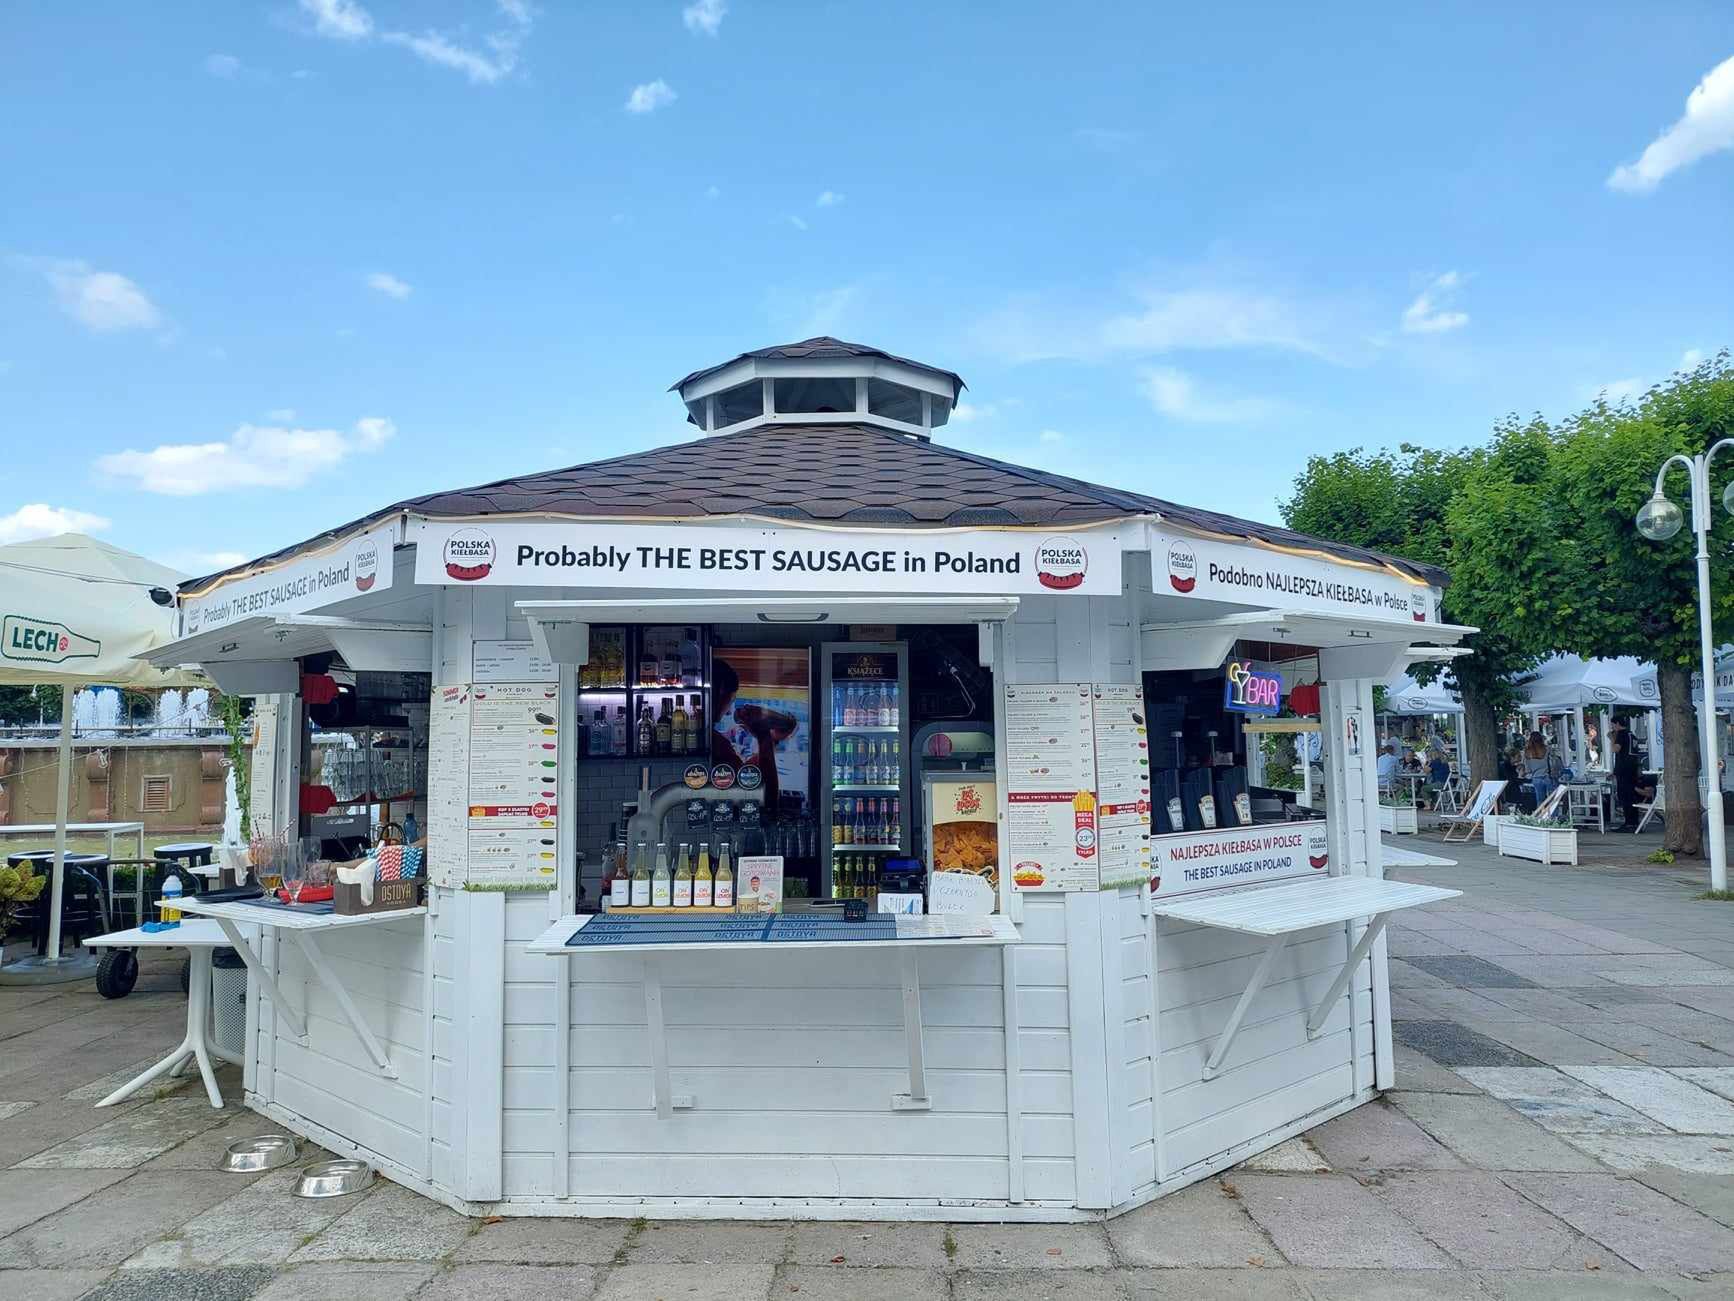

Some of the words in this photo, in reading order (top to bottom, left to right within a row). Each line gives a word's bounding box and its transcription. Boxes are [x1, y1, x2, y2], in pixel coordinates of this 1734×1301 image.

[451, 540, 490, 550] POLSKA
[1041, 549, 1082, 558] POLSKA
[1170, 551, 1194, 562] POLSKA
[516, 544, 631, 572] Probably
[636, 547, 692, 569] THE
[700, 547, 766, 571] BEST
[771, 549, 896, 573] SAUSAGE
[904, 550, 925, 573] in
[934, 551, 1020, 574] Poland
[203, 602, 232, 625] Probably
[232, 597, 248, 616] THE
[249, 590, 269, 612] BEST
[270, 578, 308, 604] SAUSAGE
[308, 577, 317, 593] in
[318, 561, 350, 589] Poland
[1208, 563, 1263, 588] Podobno
[1265, 572, 1324, 597] NAJLEPSZA
[1325, 583, 1374, 607] KIEŁBASA
[1374, 594, 1383, 607] w
[1383, 592, 1409, 612] Polsce
[12, 627, 59, 652] LECH
[1246, 676, 1279, 705] BAR
[1170, 842, 1221, 861] NAJLEPSZA
[1221, 838, 1262, 856] KIEŁBASA
[1263, 838, 1272, 849] W
[1273, 834, 1302, 848] POLSCE
[1184, 869, 1200, 882] THE
[1200, 866, 1219, 880] BEST
[1219, 860, 1253, 877] SAUSAGE
[1254, 860, 1262, 872] IN
[1262, 857, 1292, 871] POLAND
[381, 883, 412, 901] OSTOYA
